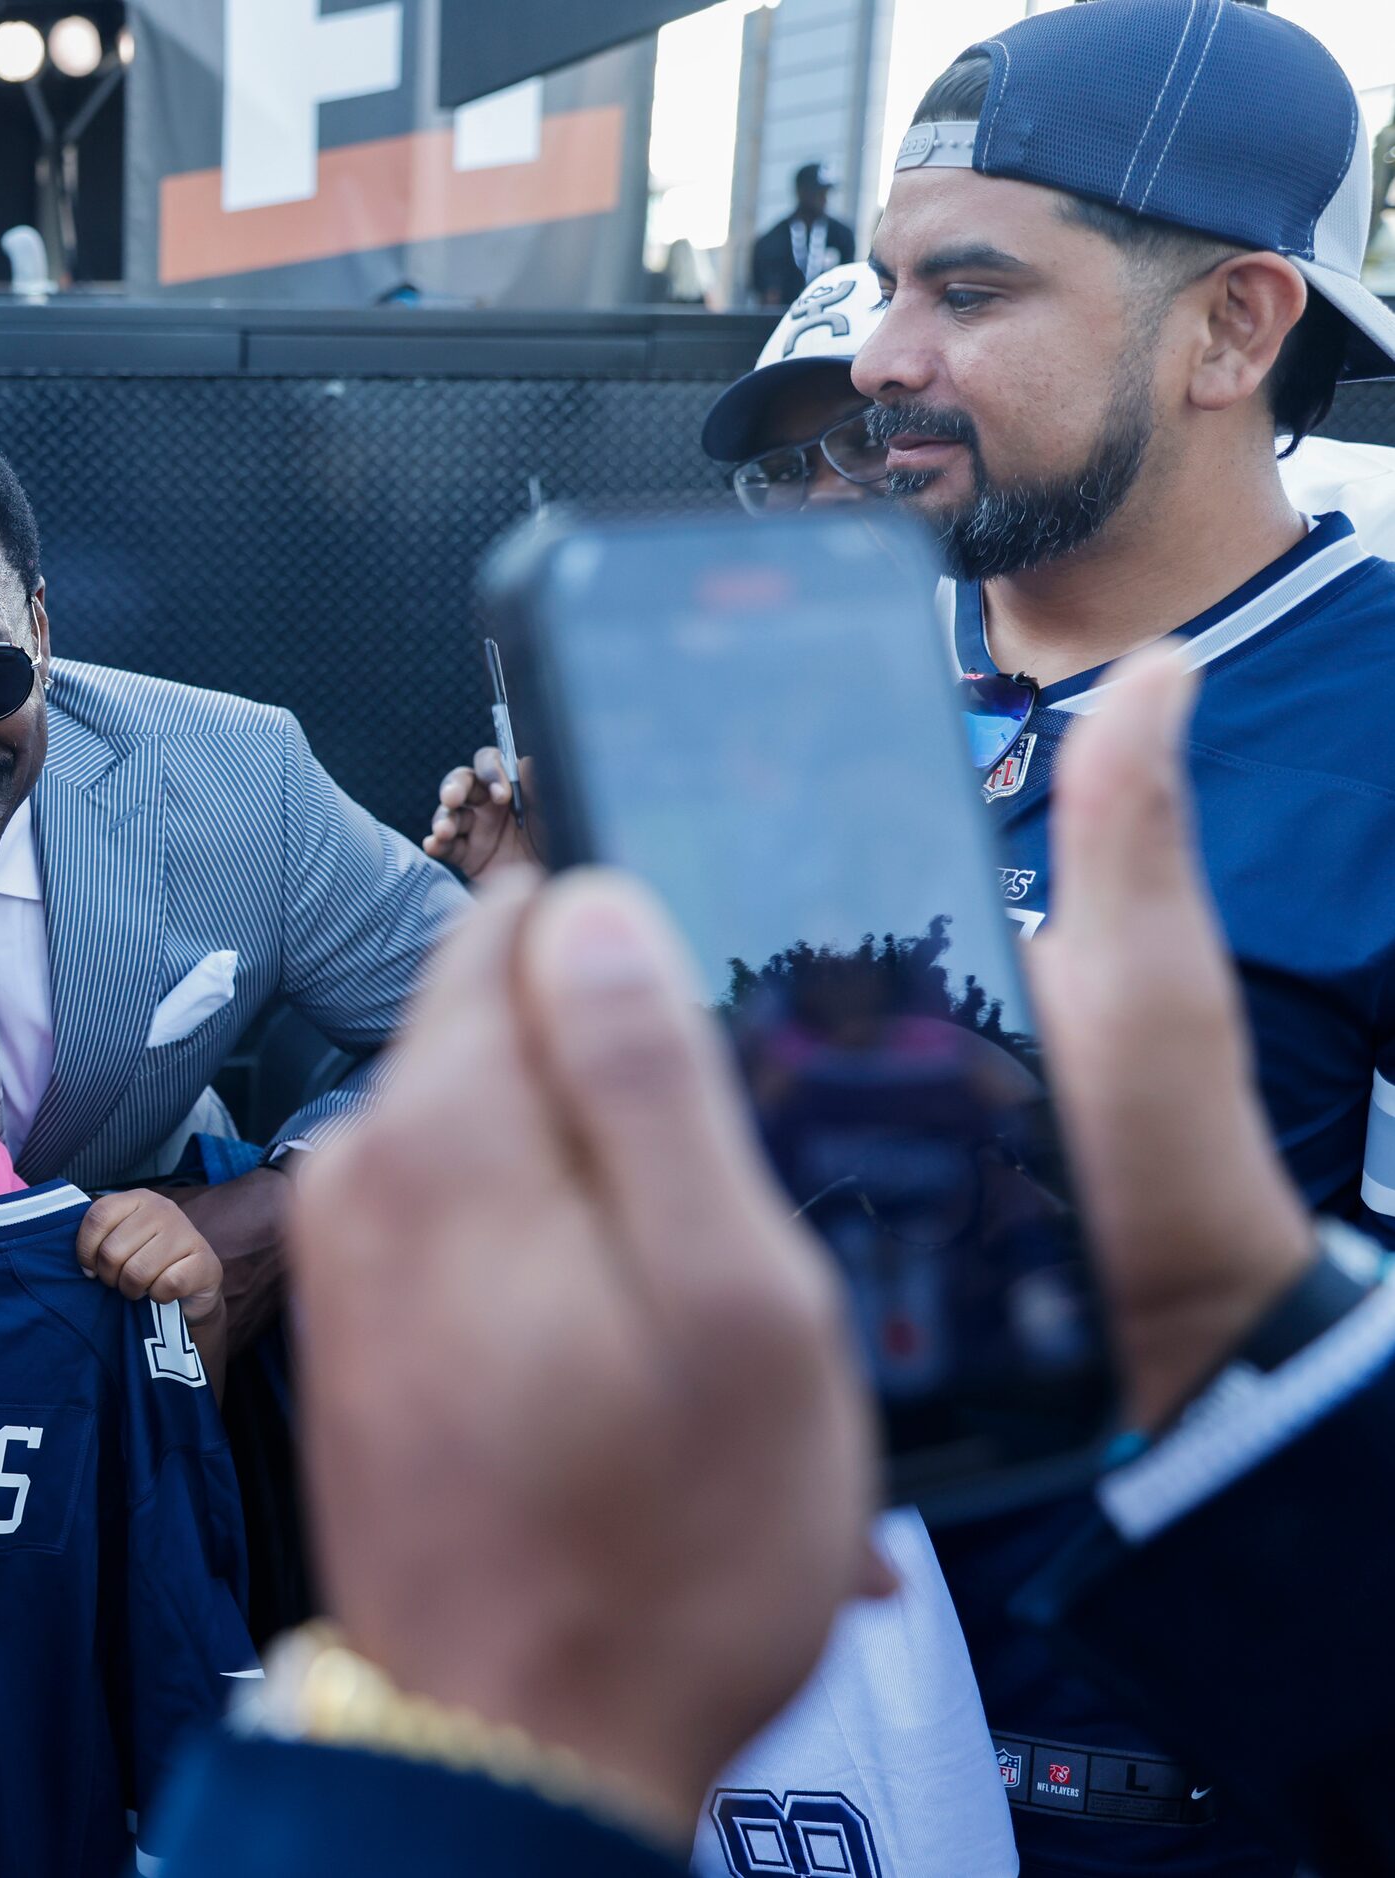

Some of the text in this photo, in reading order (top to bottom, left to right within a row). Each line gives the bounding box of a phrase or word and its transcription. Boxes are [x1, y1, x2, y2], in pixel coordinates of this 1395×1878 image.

[1125, 1762, 1149, 1792] L
[1036, 1781, 1080, 1798] NFL PLAYERS
